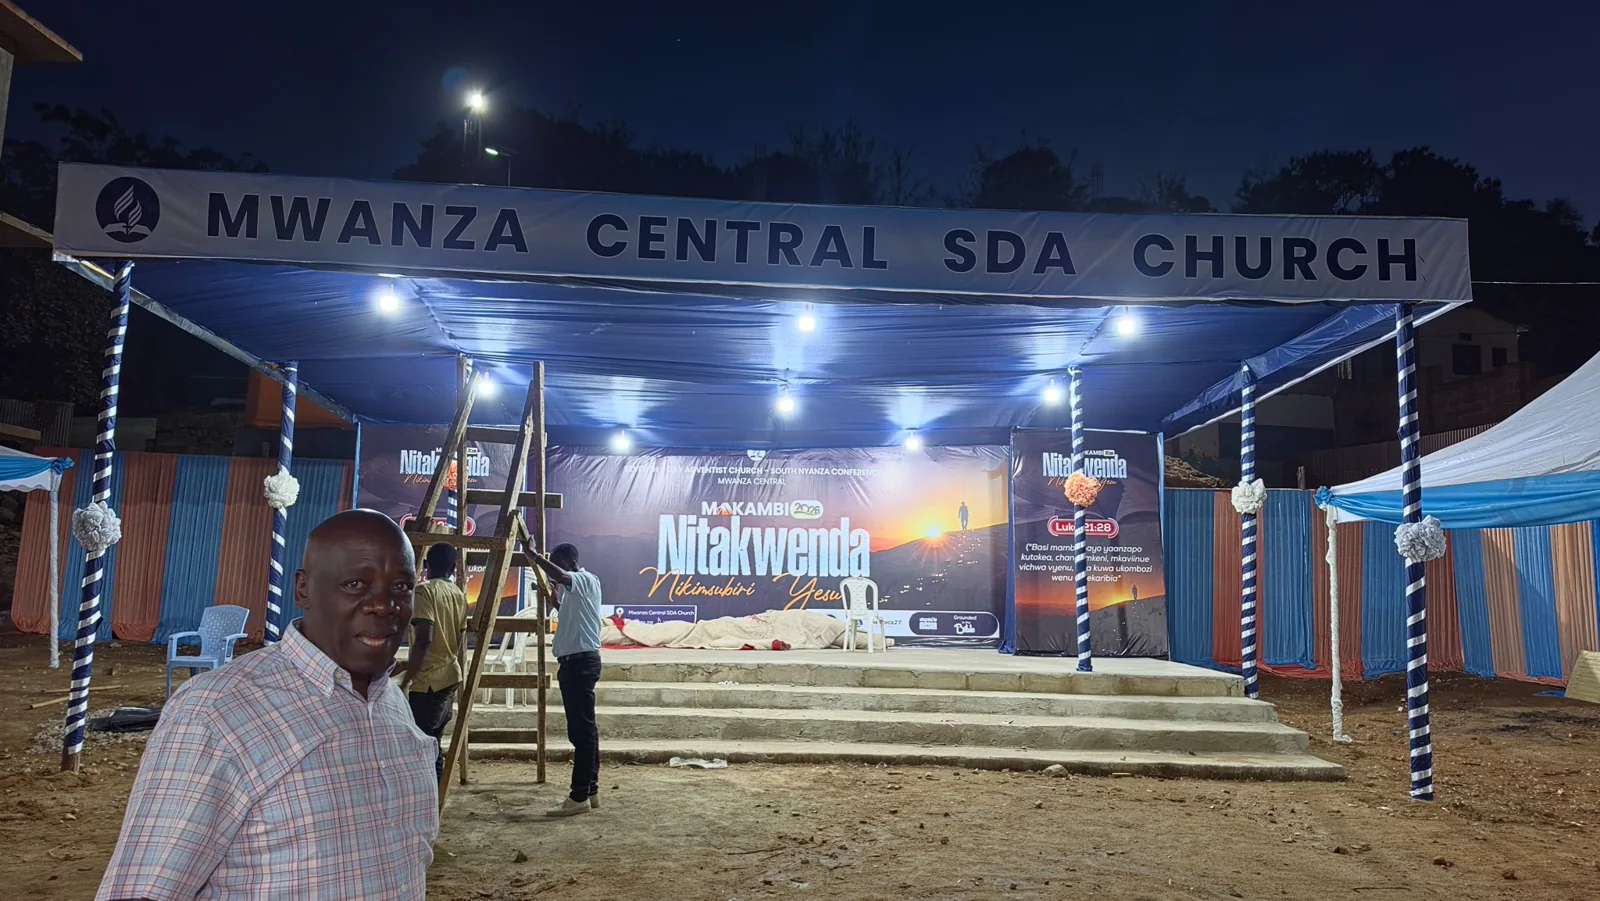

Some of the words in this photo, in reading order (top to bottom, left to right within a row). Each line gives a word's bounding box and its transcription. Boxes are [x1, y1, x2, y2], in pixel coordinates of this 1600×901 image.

[207, 192, 529, 253] MWANZA
[585, 213, 888, 270] CENTRAL
[943, 228, 1077, 276] SDA
[1133, 233, 1417, 282] CHURCH
[685, 466, 727, 474] ADVENTIST
[728, 467, 763, 475] CHURCH
[770, 467, 797, 475] SOUTH
[798, 467, 830, 475] NYANZA
[701, 501, 789, 516] MAKAMBI
[793, 502, 821, 514] 2026
[1056, 522, 1075, 531] Luk
[1085, 523, 1111, 532] 21:28
[658, 514, 871, 577] Nitakwenda
[1103, 546, 1142, 554] yaanzapo
[1021, 553, 1053, 561] kutokea,
[1110, 555, 1150, 563] mkaviinue
[1019, 563, 1047, 571] vichwa
[1048, 565, 1074, 573] vyenu,
[1093, 564, 1114, 572] kuwa
[1115, 565, 1153, 573] ukombozi
[772, 573, 842, 611] Yesu
[954, 623, 976, 634] Bible
